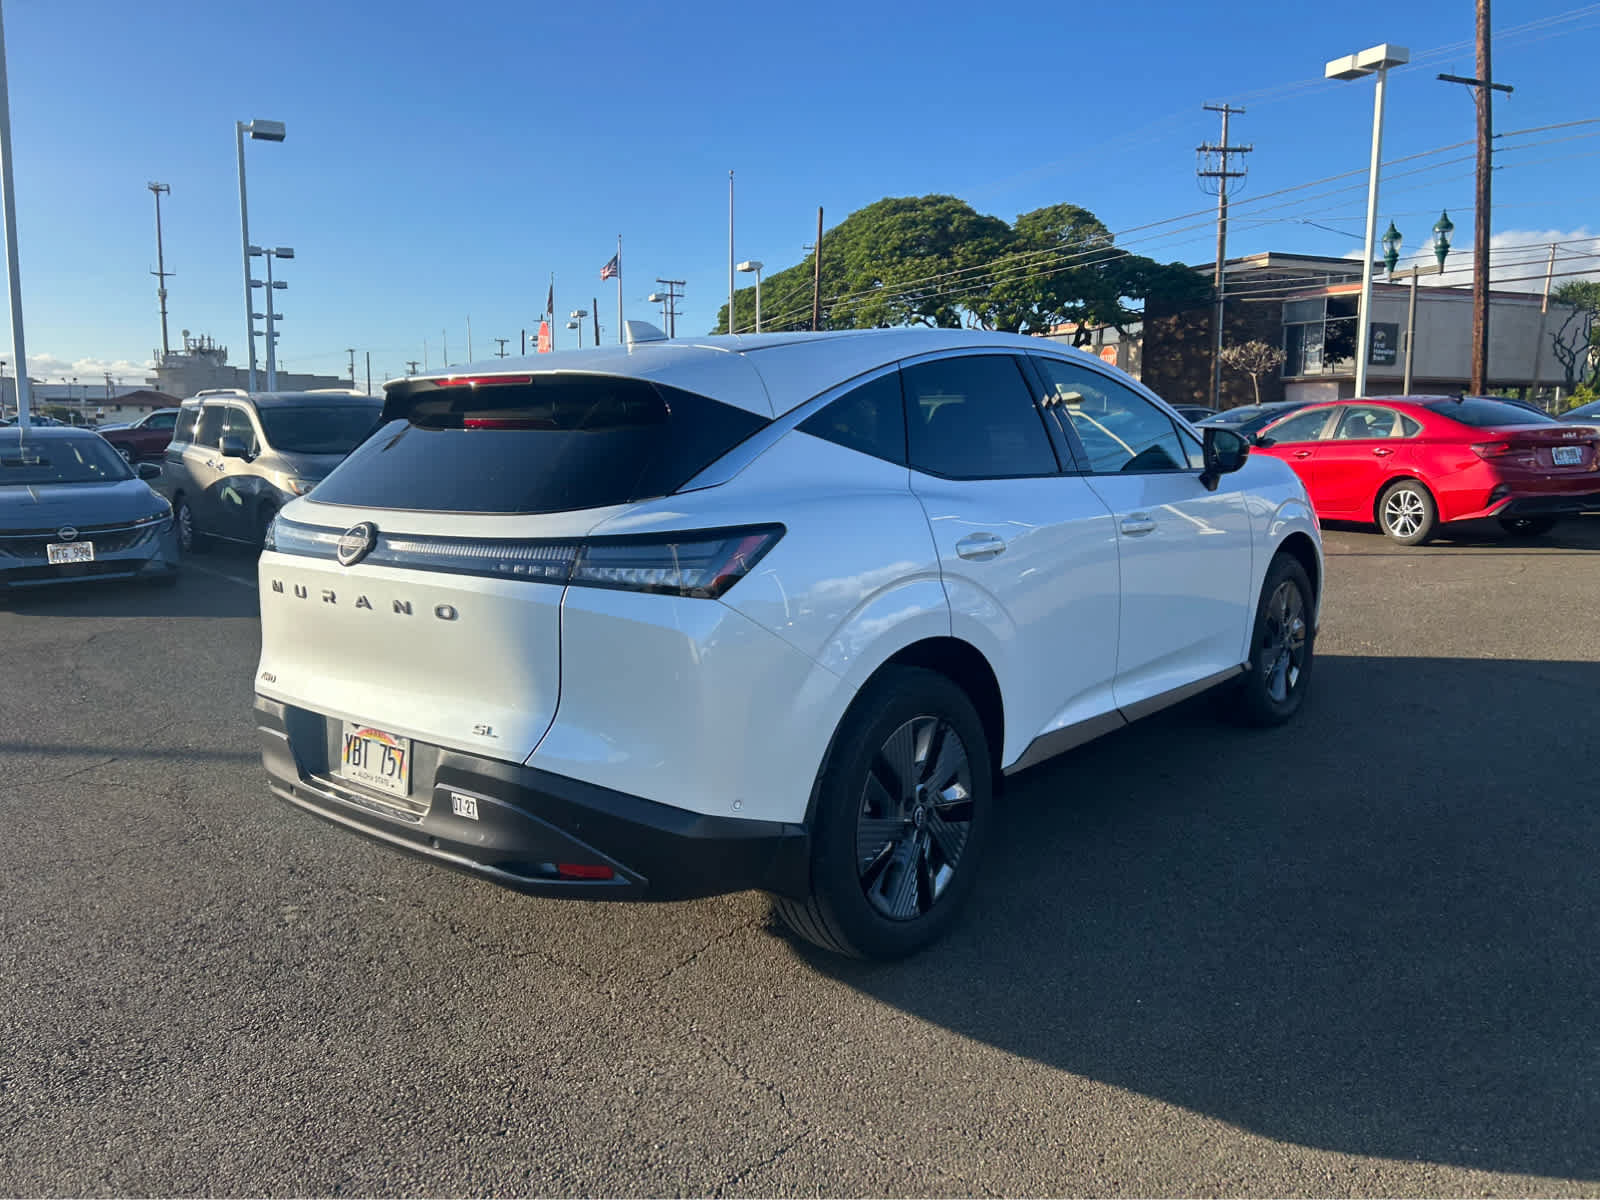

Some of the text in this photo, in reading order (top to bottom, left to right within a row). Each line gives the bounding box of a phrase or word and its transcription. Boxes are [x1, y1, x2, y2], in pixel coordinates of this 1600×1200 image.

[272, 579, 459, 621] MURANO
[472, 724, 499, 738] SL
[345, 733, 405, 779] YBT 757
